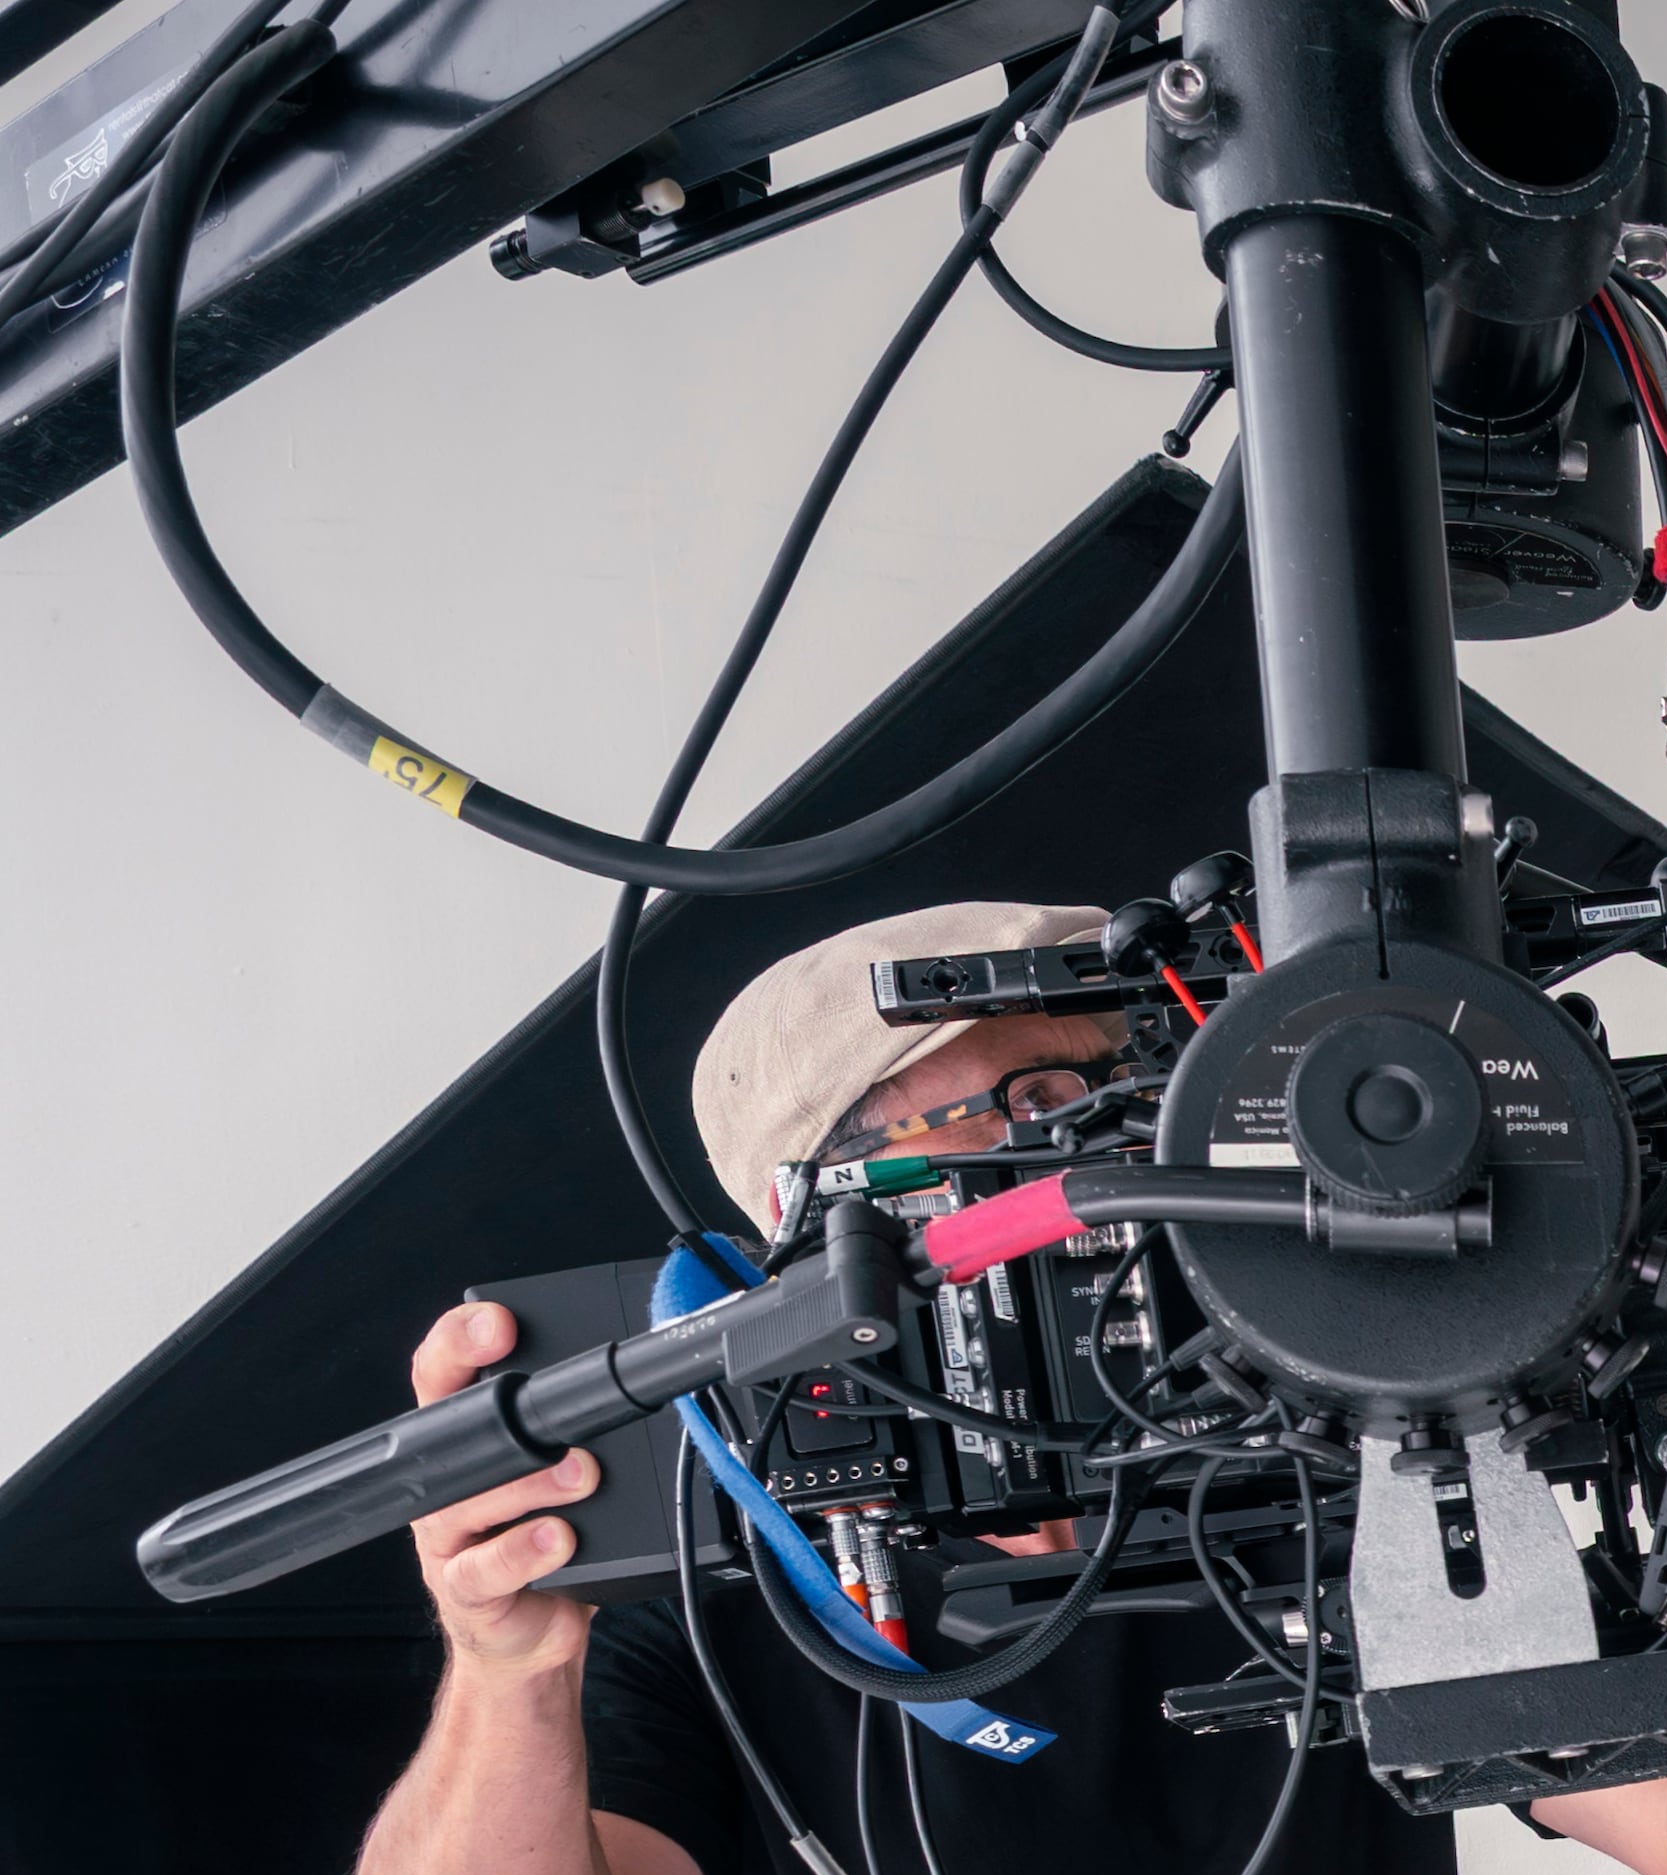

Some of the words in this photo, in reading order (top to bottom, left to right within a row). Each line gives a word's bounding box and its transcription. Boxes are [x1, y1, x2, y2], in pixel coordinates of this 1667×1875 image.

[1503, 550, 1577, 563] Weaver
[1482, 1059, 1539, 1081] Wea
[1238, 1098, 1286, 1107] 829.3296
[1233, 1112, 1256, 1122] USA
[1258, 1112, 1287, 1122] ornia,
[1506, 1105, 1540, 1118] Fluid
[1244, 1127, 1280, 1136] Monica
[1506, 1121, 1569, 1136] Balanced
[1071, 1287, 1095, 1297] SYN
[1075, 1336, 1092, 1346] SD
[1075, 1346, 1092, 1357] RE
[1002, 1389, 1015, 1420] Modul
[1015, 1388, 1028, 1420] Power
[1024, 1444, 1038, 1480] ibution
[1003, 1735, 1037, 1754] TCS
